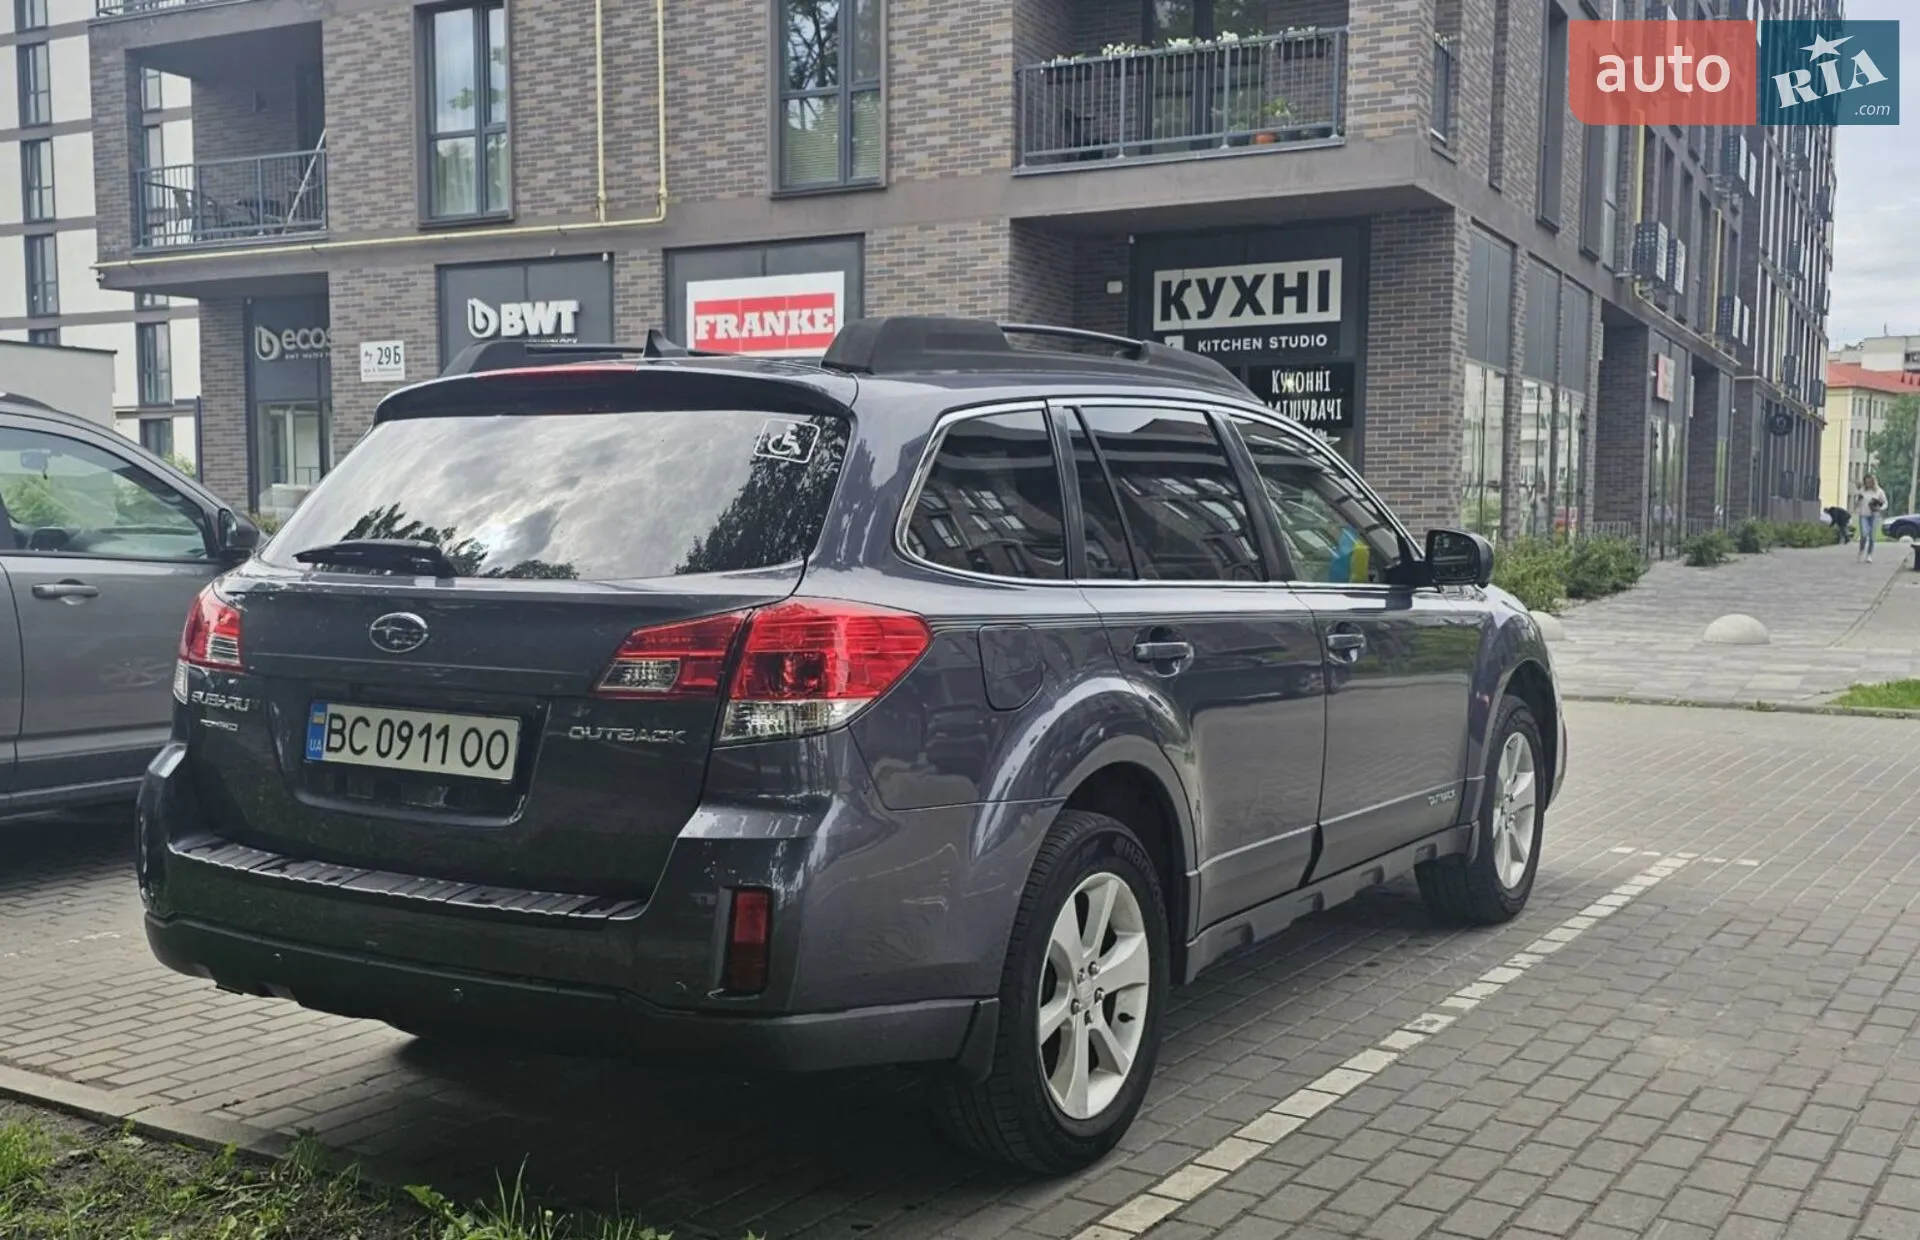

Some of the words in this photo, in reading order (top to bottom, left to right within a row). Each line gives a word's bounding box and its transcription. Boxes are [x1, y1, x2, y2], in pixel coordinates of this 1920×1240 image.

[1160, 269, 1331, 322] КУХНІ
[500, 299, 579, 337] BWT
[695, 307, 835, 341] FRANKE
[1197, 337, 1263, 353] KITCHEN
[1269, 333, 1329, 349] STUDIO
[1267, 397, 1343, 421] МІШУВАЧІ
[309, 739, 323, 751] UA
[568, 725, 687, 745] OUTBACK
